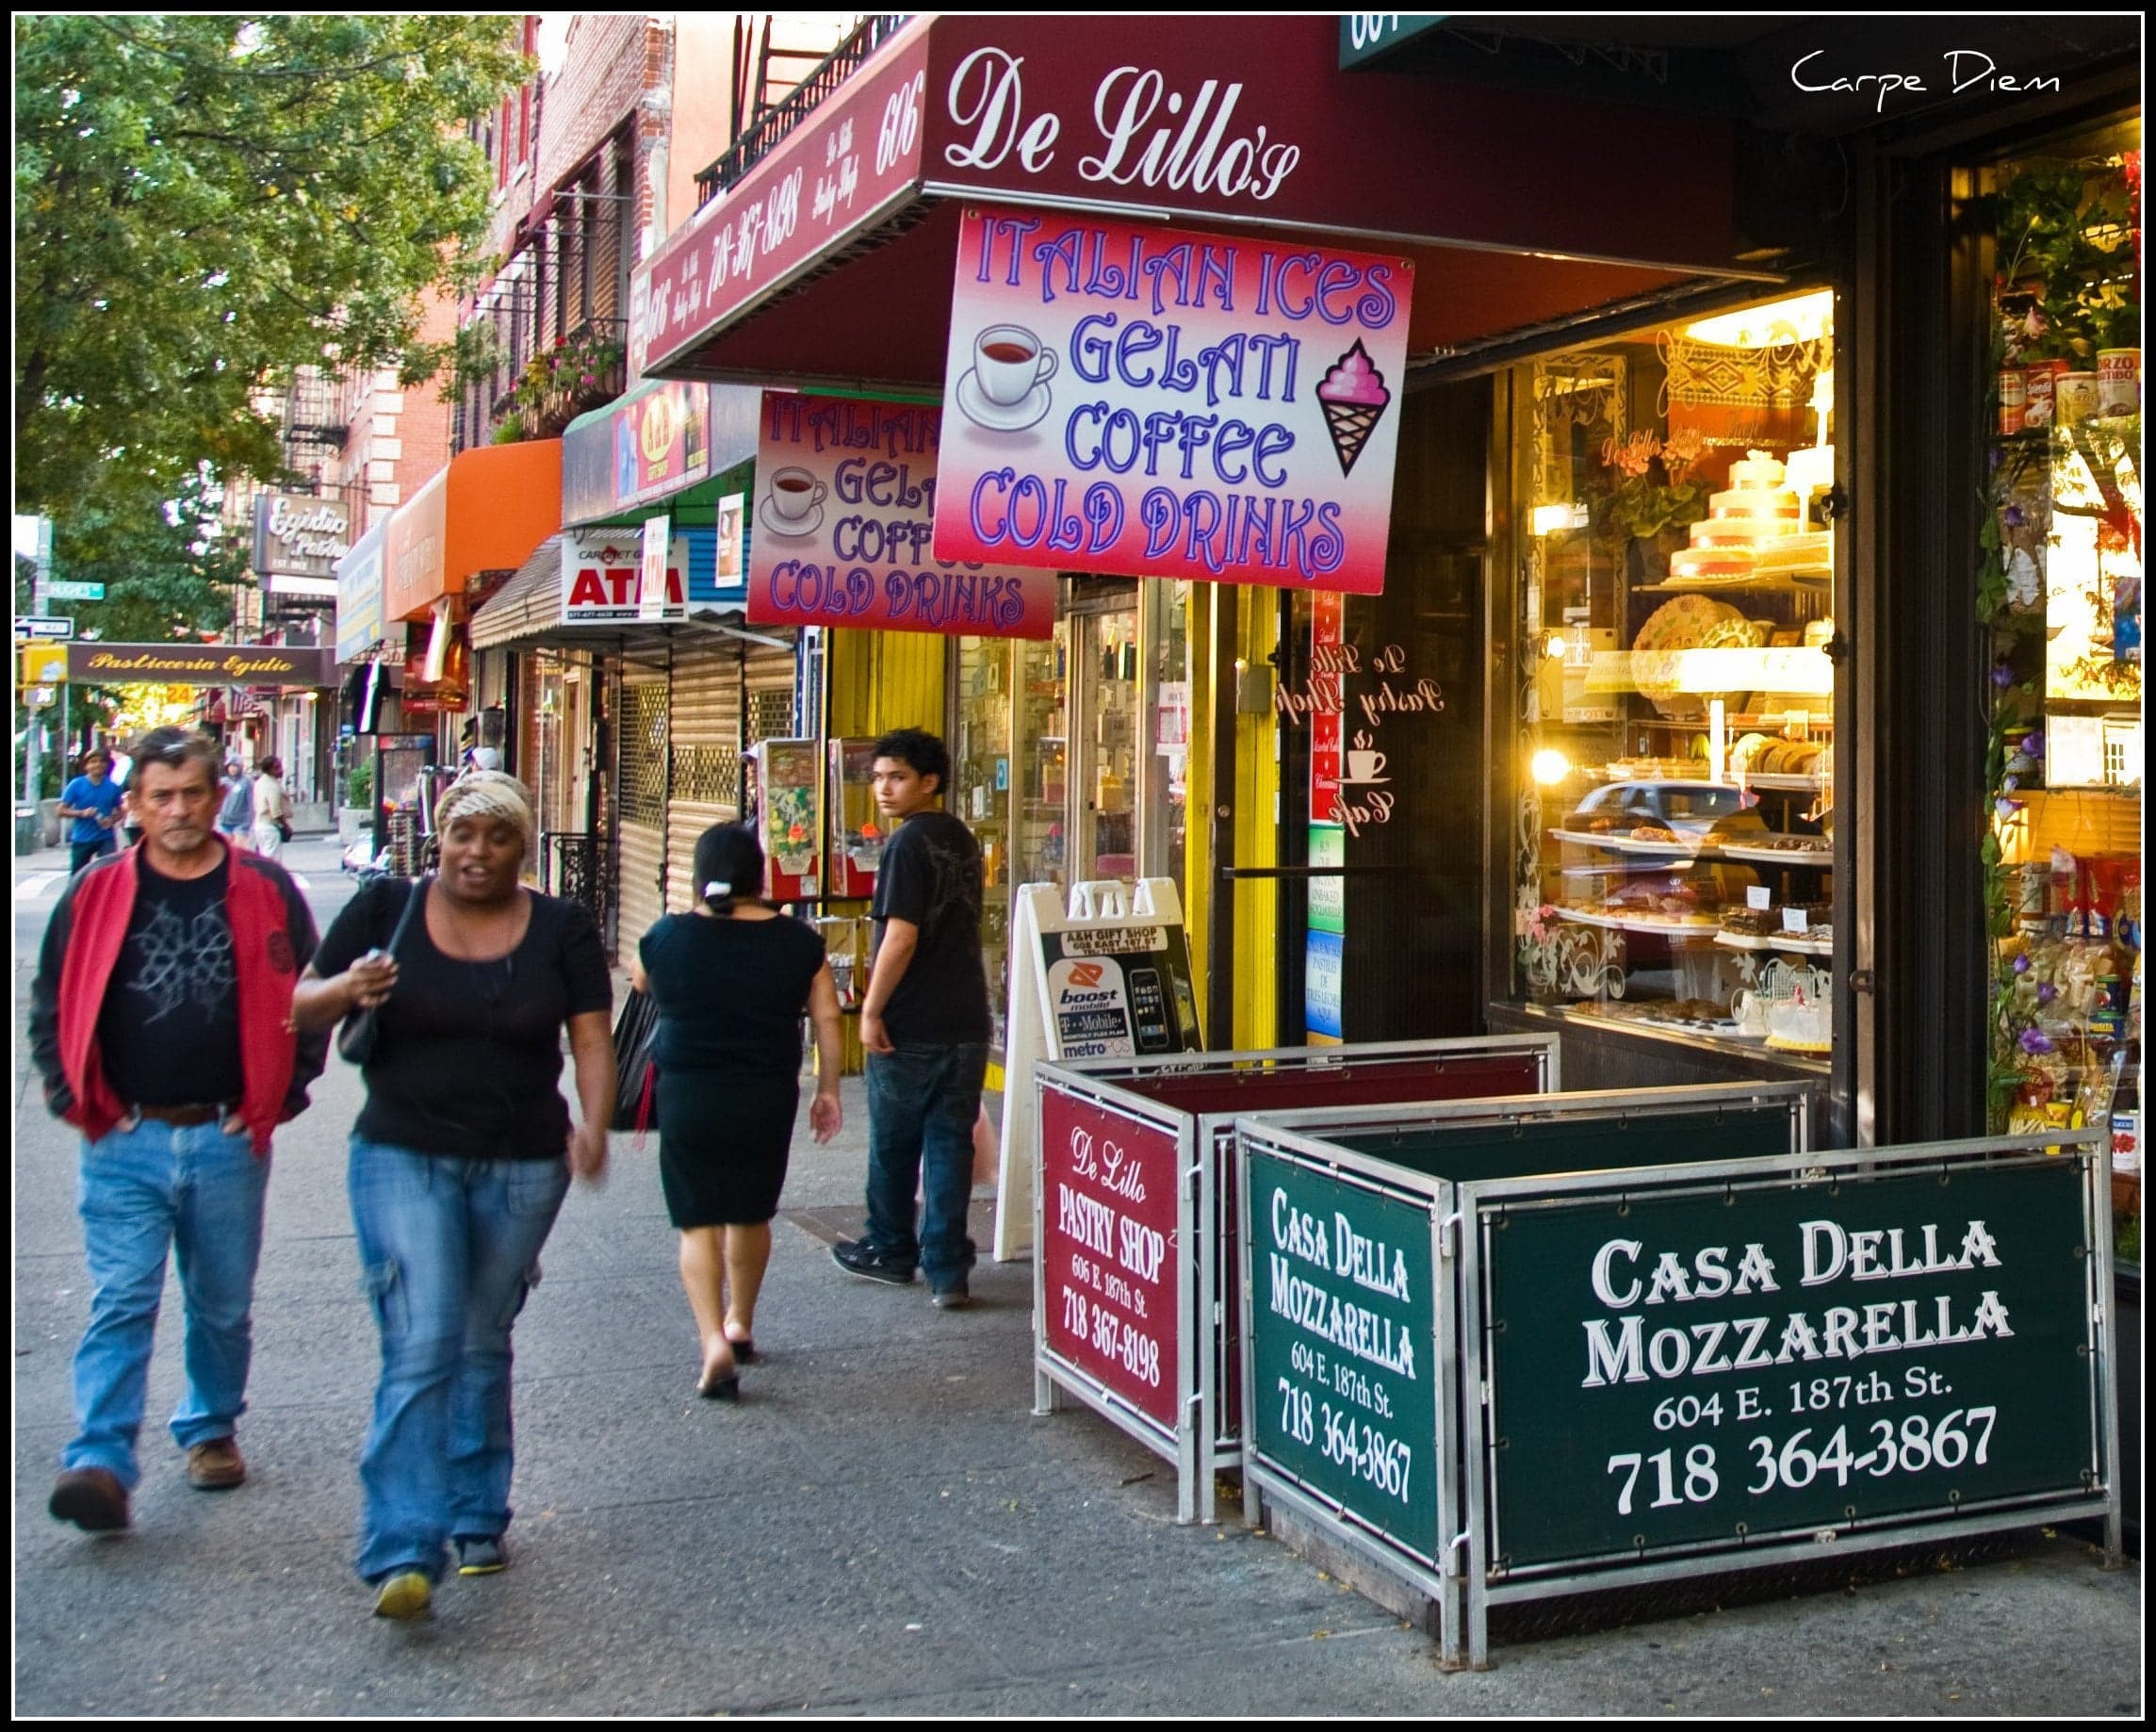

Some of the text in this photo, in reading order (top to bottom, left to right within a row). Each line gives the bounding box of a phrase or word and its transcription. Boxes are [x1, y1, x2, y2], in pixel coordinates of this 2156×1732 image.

[875, 69, 924, 177] 606
[944, 46, 1300, 201] De Lillo's
[977, 217, 1396, 330] ITALIAN ICES
[1070, 312, 1302, 406] GELATI
[770, 397, 942, 459] ITALIAN
[1065, 401, 1295, 488] COFFEE
[270, 498, 349, 544] Egidio
[970, 467, 1346, 580] COLD DRINKS
[770, 559, 1024, 628] COLD DRINKS
[222, 655, 294, 677] Egidio
[1067, 927, 1157, 942] A&H GIFT SHOP
[1095, 940, 1120, 949] EAST
[1059, 989, 1119, 1005] boost
[1070, 1002, 1110, 1012] mobile
[1070, 1125, 1147, 1204] De Lillo
[1058, 1183, 1166, 1285] PASTRY SHOP
[1271, 1186, 1412, 1303] CASA DELLA
[1591, 1219, 2003, 1309] CASA DELLA
[1071, 1253, 1148, 1319] 606 E. 187th St.
[1270, 1251, 1416, 1381] MOZZARELLA
[1062, 1284, 1161, 1388] 718 367-8198
[1291, 1340, 1394, 1419] 604 E. 187th St.
[1581, 1290, 2016, 1388] MOZZARELLA
[1279, 1376, 1412, 1504] 718 364-3867
[1652, 1365, 1953, 1431] 604 E. 187th St.
[1607, 1405, 1998, 1515] 718 364-3867
